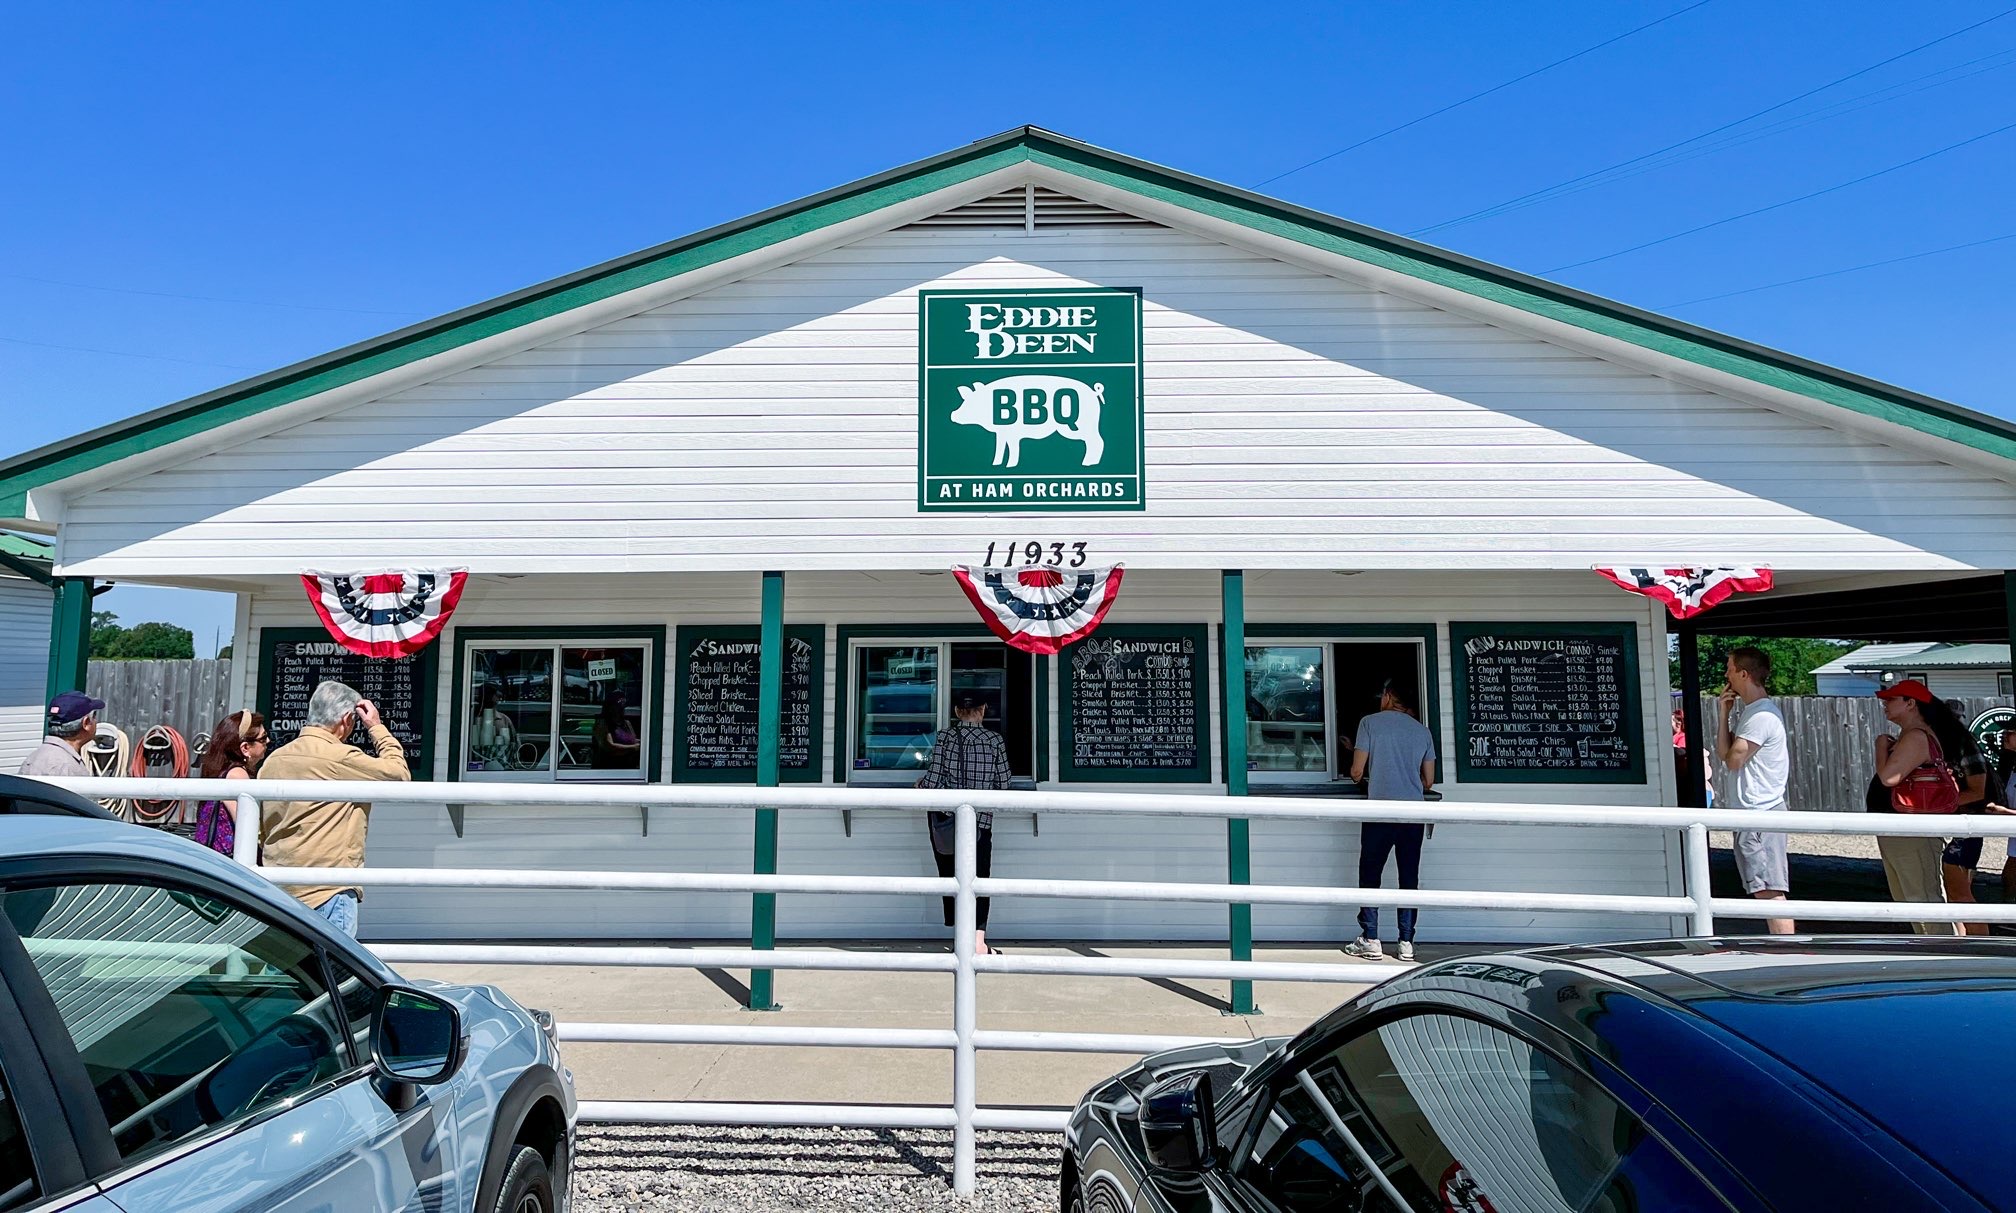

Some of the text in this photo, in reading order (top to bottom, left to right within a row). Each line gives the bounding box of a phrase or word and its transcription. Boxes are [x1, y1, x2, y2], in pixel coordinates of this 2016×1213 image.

[964, 303, 1098, 333] EDDIE
[973, 330, 1098, 359] DEEN
[992, 388, 1080, 431] BBQ
[939, 482, 1125, 498] AT HAM ORCHARDS
[983, 541, 1088, 567] 11933
[708, 641, 761, 655] SANDWI
[1113, 640, 1180, 653] SANDWICH
[1497, 640, 1564, 651] SANDWICH
[1565, 645, 1591, 655] COMBO
[591, 668, 613, 676] CLOSED
[1478, 666, 1503, 676] Chopped
[1479, 684, 1505, 692] Smoked
[1469, 736, 1490, 756] SIDE
